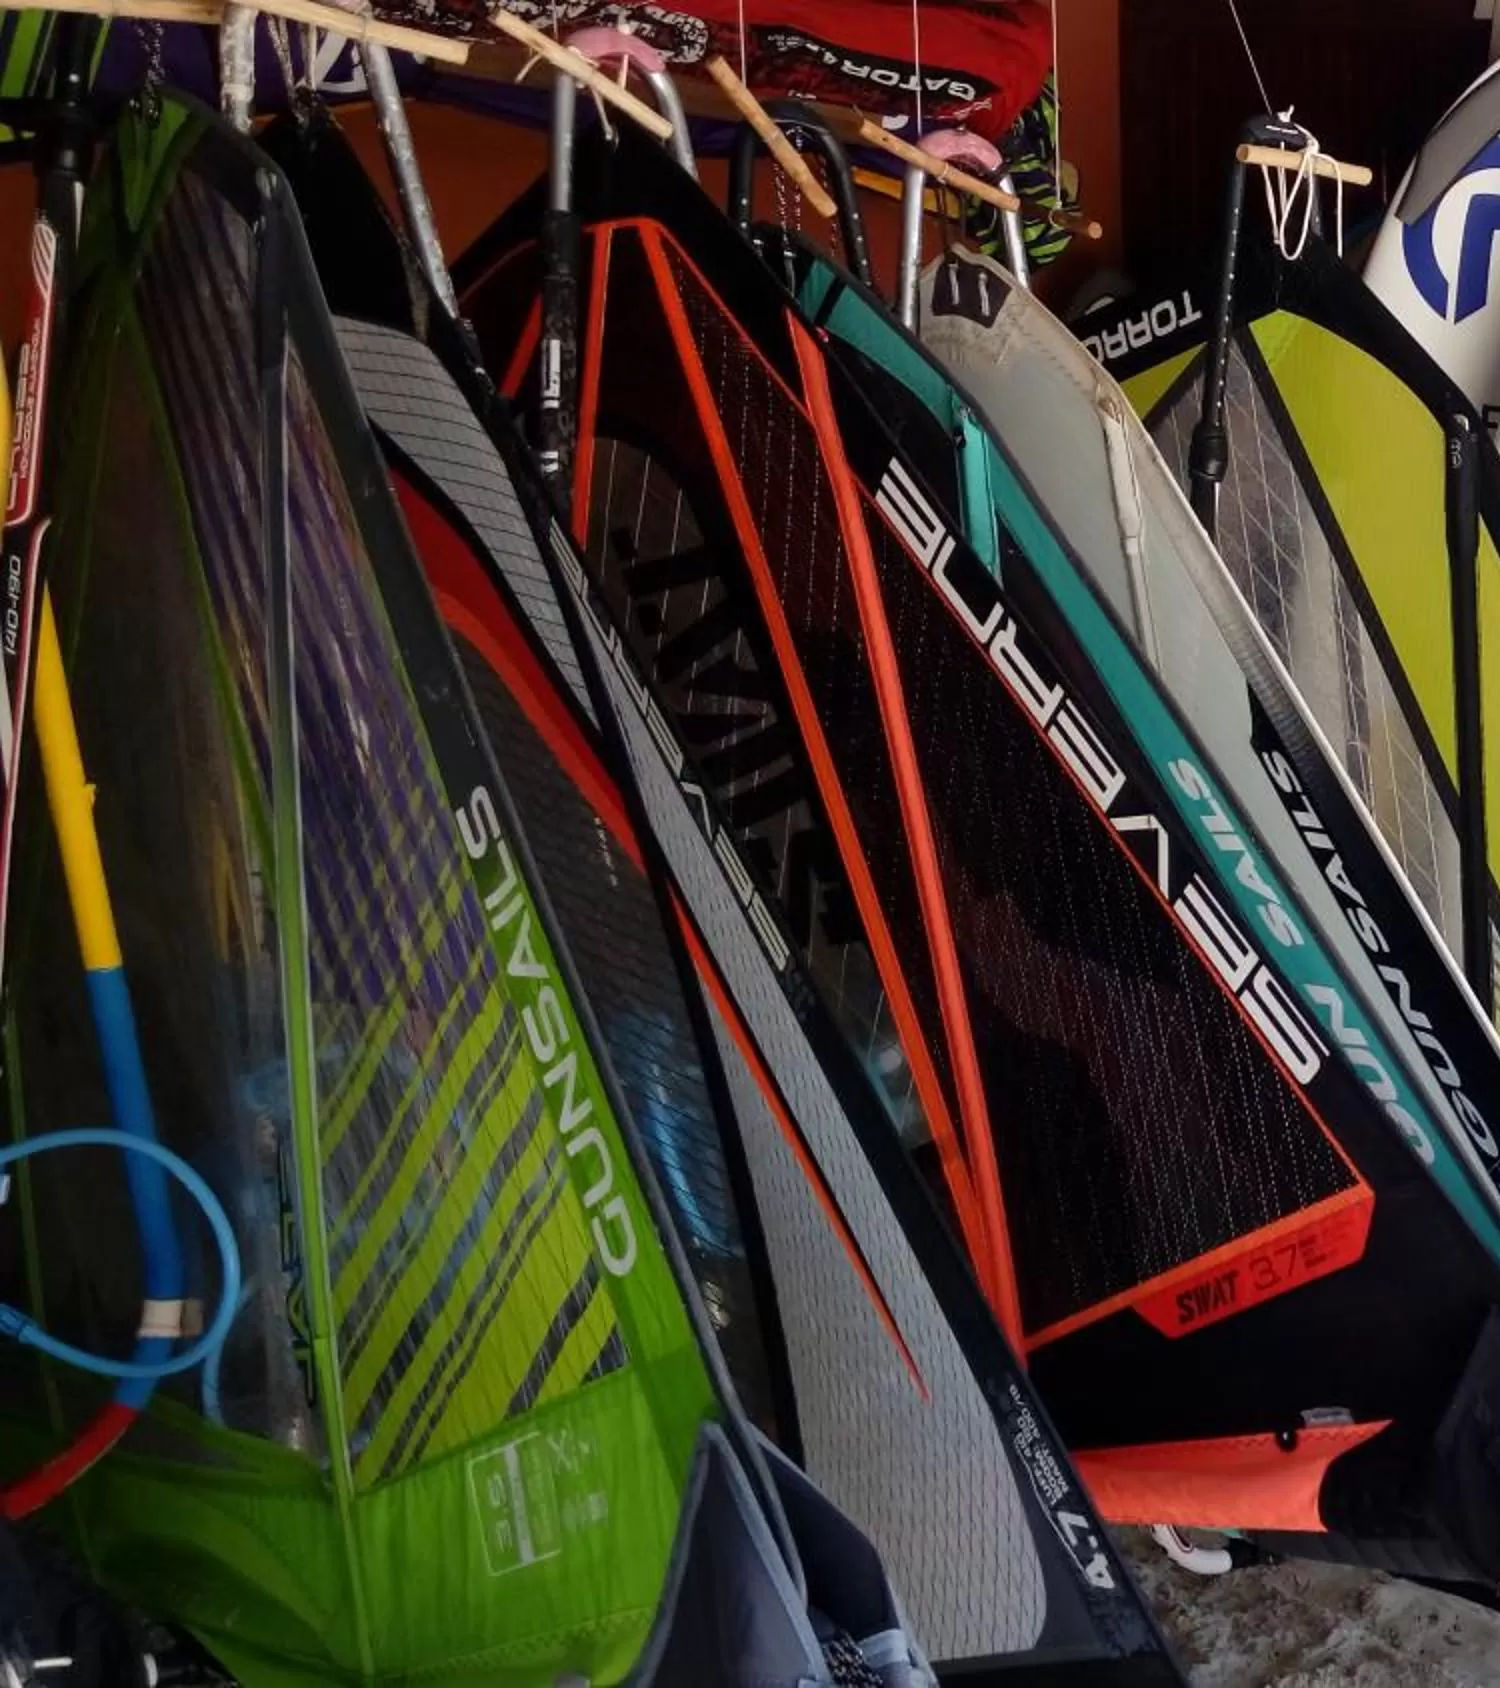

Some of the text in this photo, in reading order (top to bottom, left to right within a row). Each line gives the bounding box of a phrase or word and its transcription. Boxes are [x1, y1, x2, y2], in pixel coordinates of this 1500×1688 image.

[840, 58, 976, 102] GATOR
[875, 458, 1330, 1085] SEVERNE
[1168, 758, 1304, 947] SAILS
[1261, 749, 1500, 1159] GUN SAILS
[1303, 981, 1435, 1165] GUN
[1175, 1268, 1241, 1326] SWAT
[1057, 1512, 1115, 1589] 4.7
